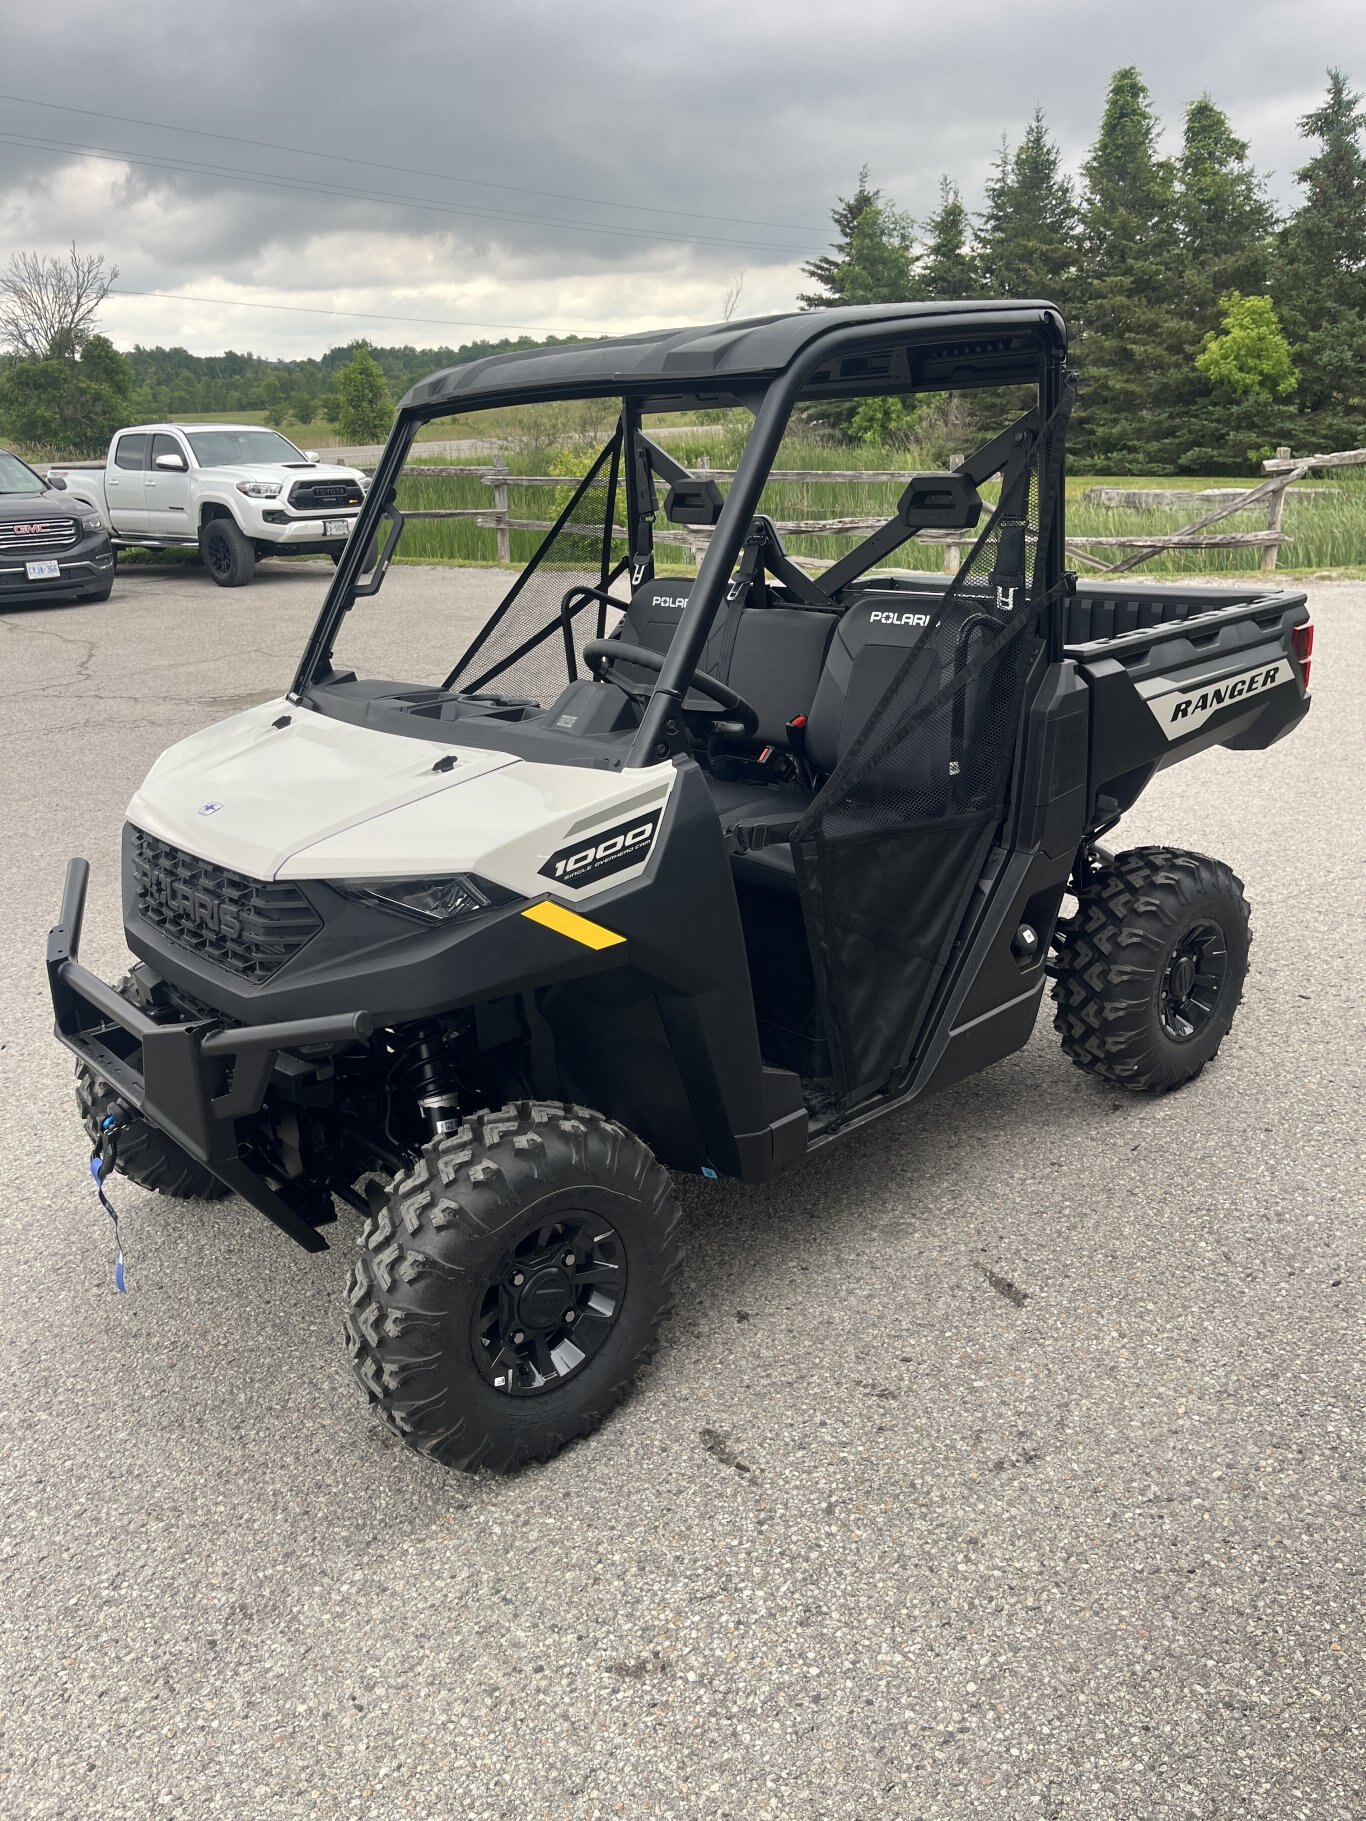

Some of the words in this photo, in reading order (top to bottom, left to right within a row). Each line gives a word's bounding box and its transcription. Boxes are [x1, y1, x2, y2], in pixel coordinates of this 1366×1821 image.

[315, 487, 345, 495] TOYOTA
[14, 524, 49, 534] GMC
[869, 611, 941, 627] POLARI
[1170, 666, 1280, 723] RANGER
[555, 822, 653, 877] 1000
[564, 864, 593, 880] SINGLE
[594, 847, 634, 867] OVERHEAD
[634, 839, 651, 850] CAM
[134, 857, 240, 939] POLARIS
